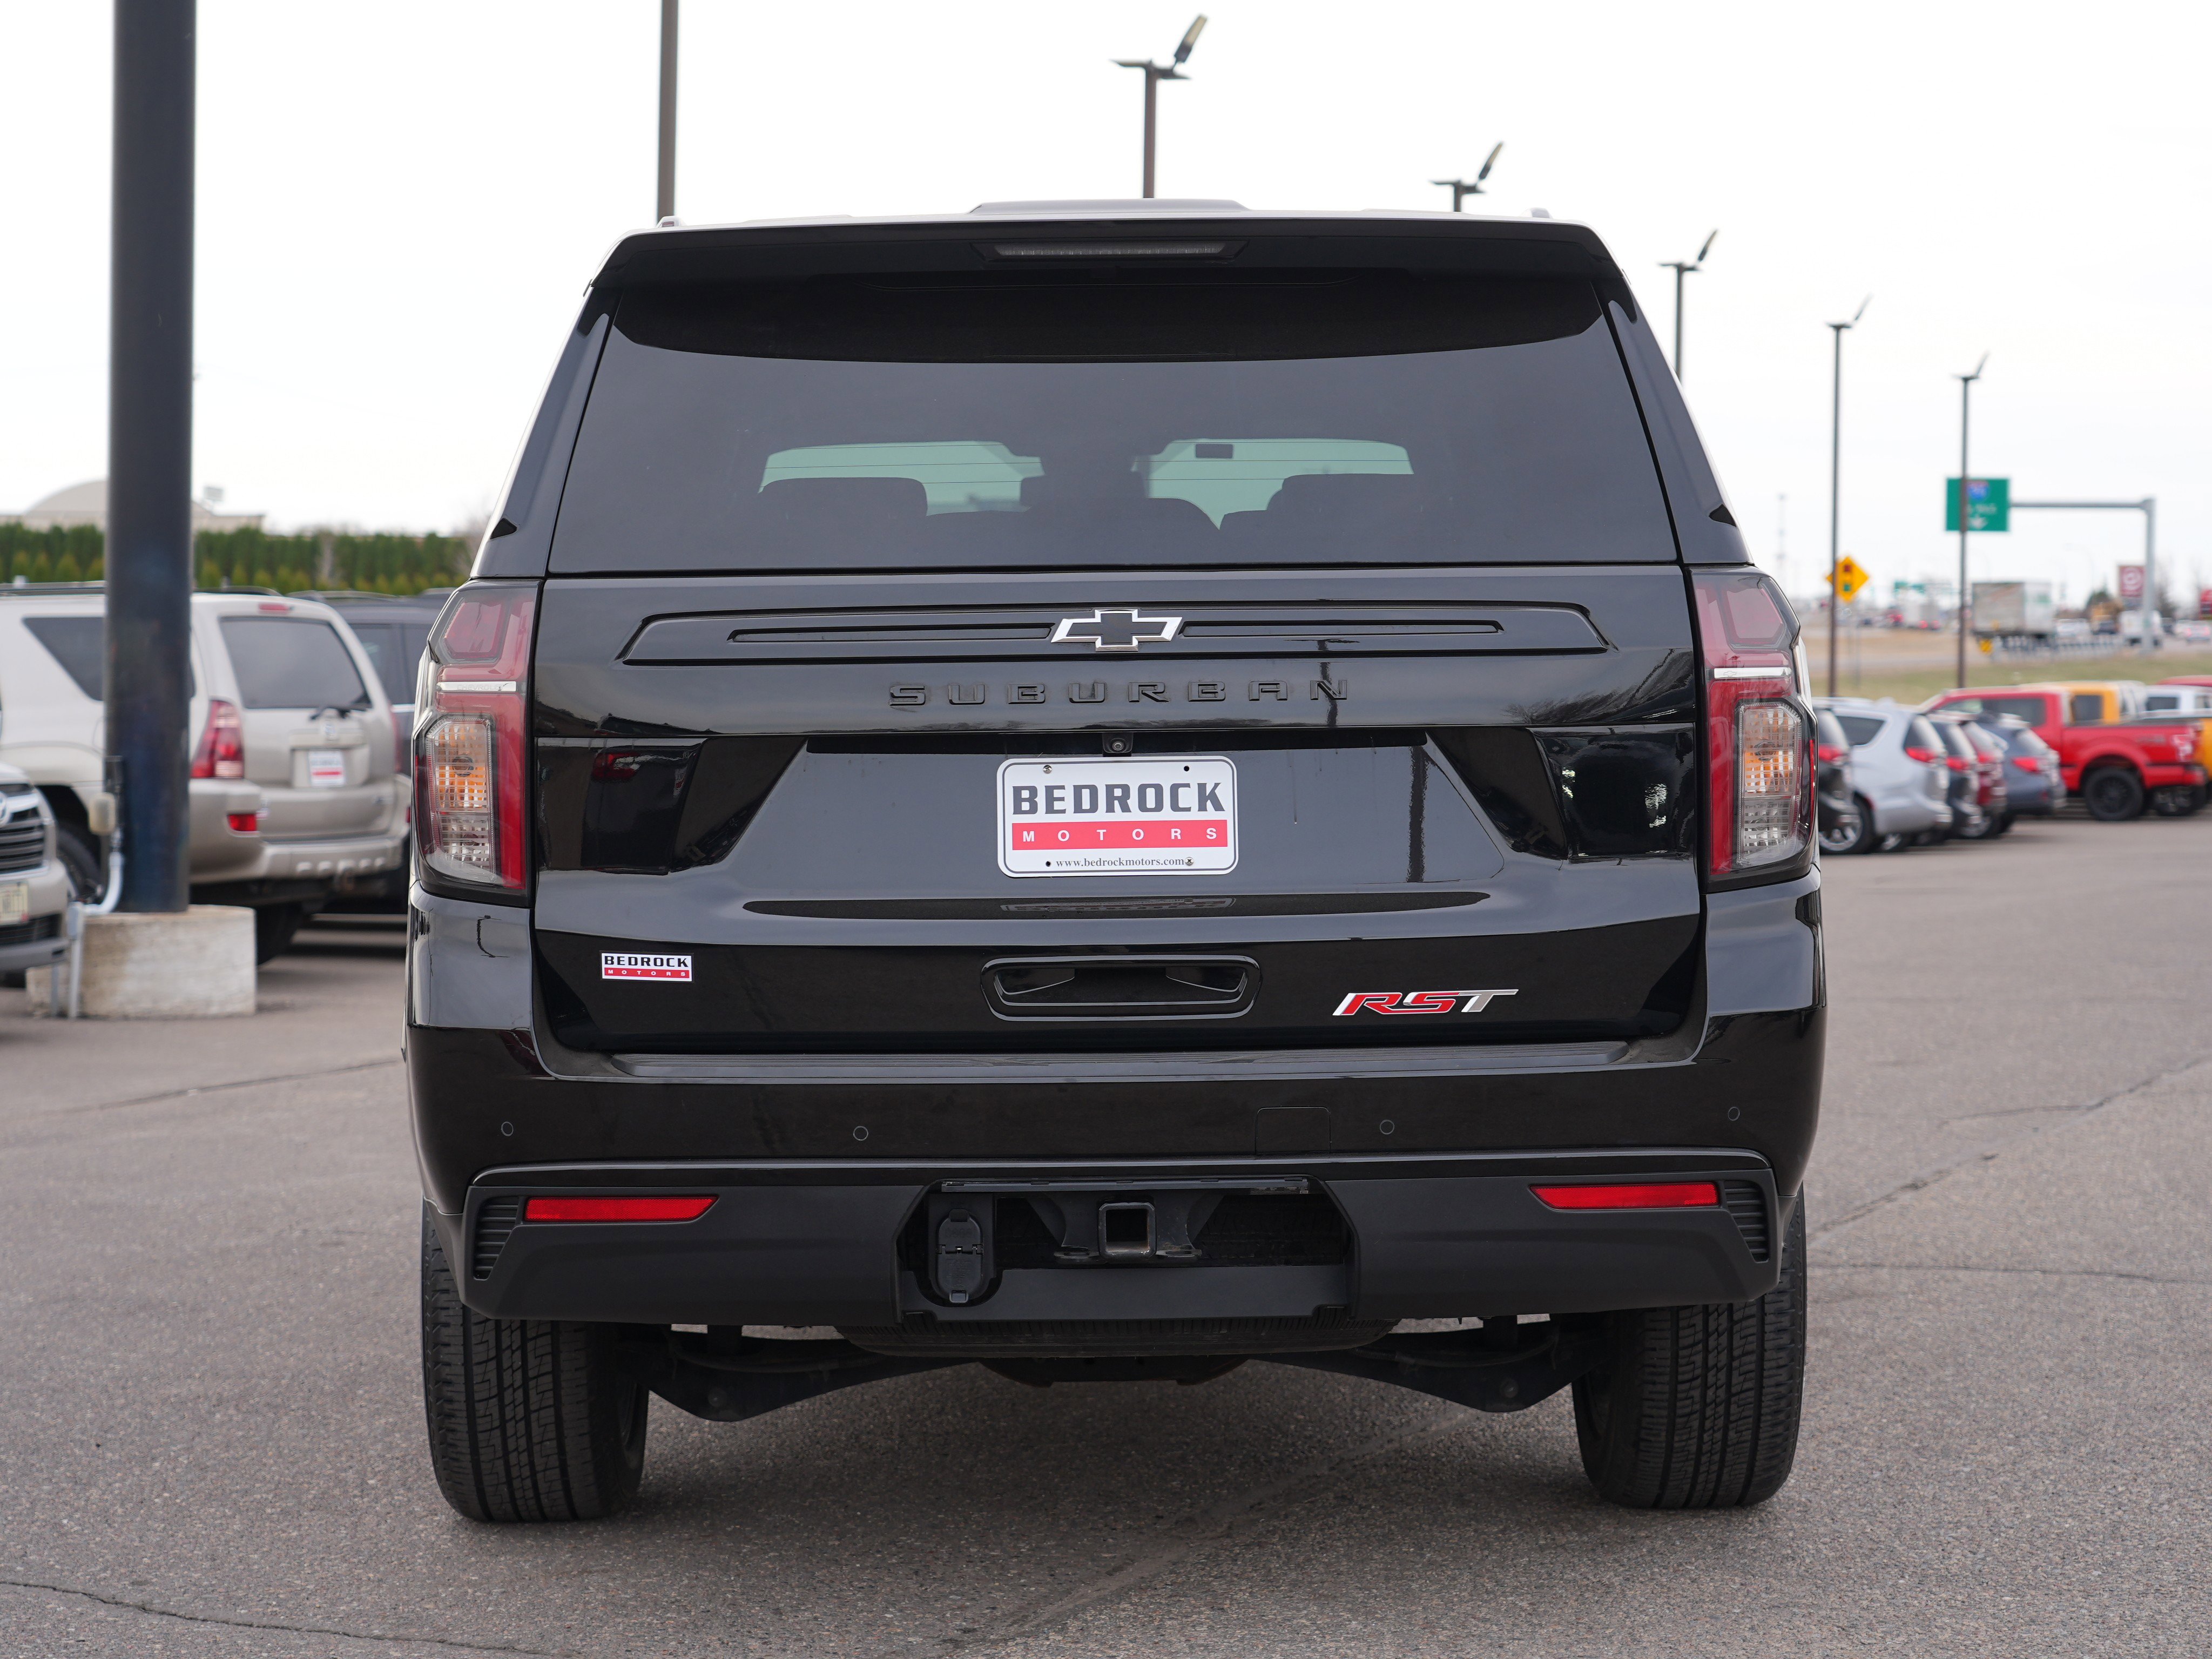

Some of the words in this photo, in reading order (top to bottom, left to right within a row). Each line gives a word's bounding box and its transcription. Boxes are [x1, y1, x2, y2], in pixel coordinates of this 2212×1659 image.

[889, 680, 1347, 705] SUBURBAN
[1012, 783, 1225, 815] BEDROCK
[1022, 827, 1217, 842] MOTORS
[1056, 858, 1184, 867] www.bedrockmotors.com
[604, 956, 689, 967] BEDROCK
[1332, 989, 1519, 1016] RST
